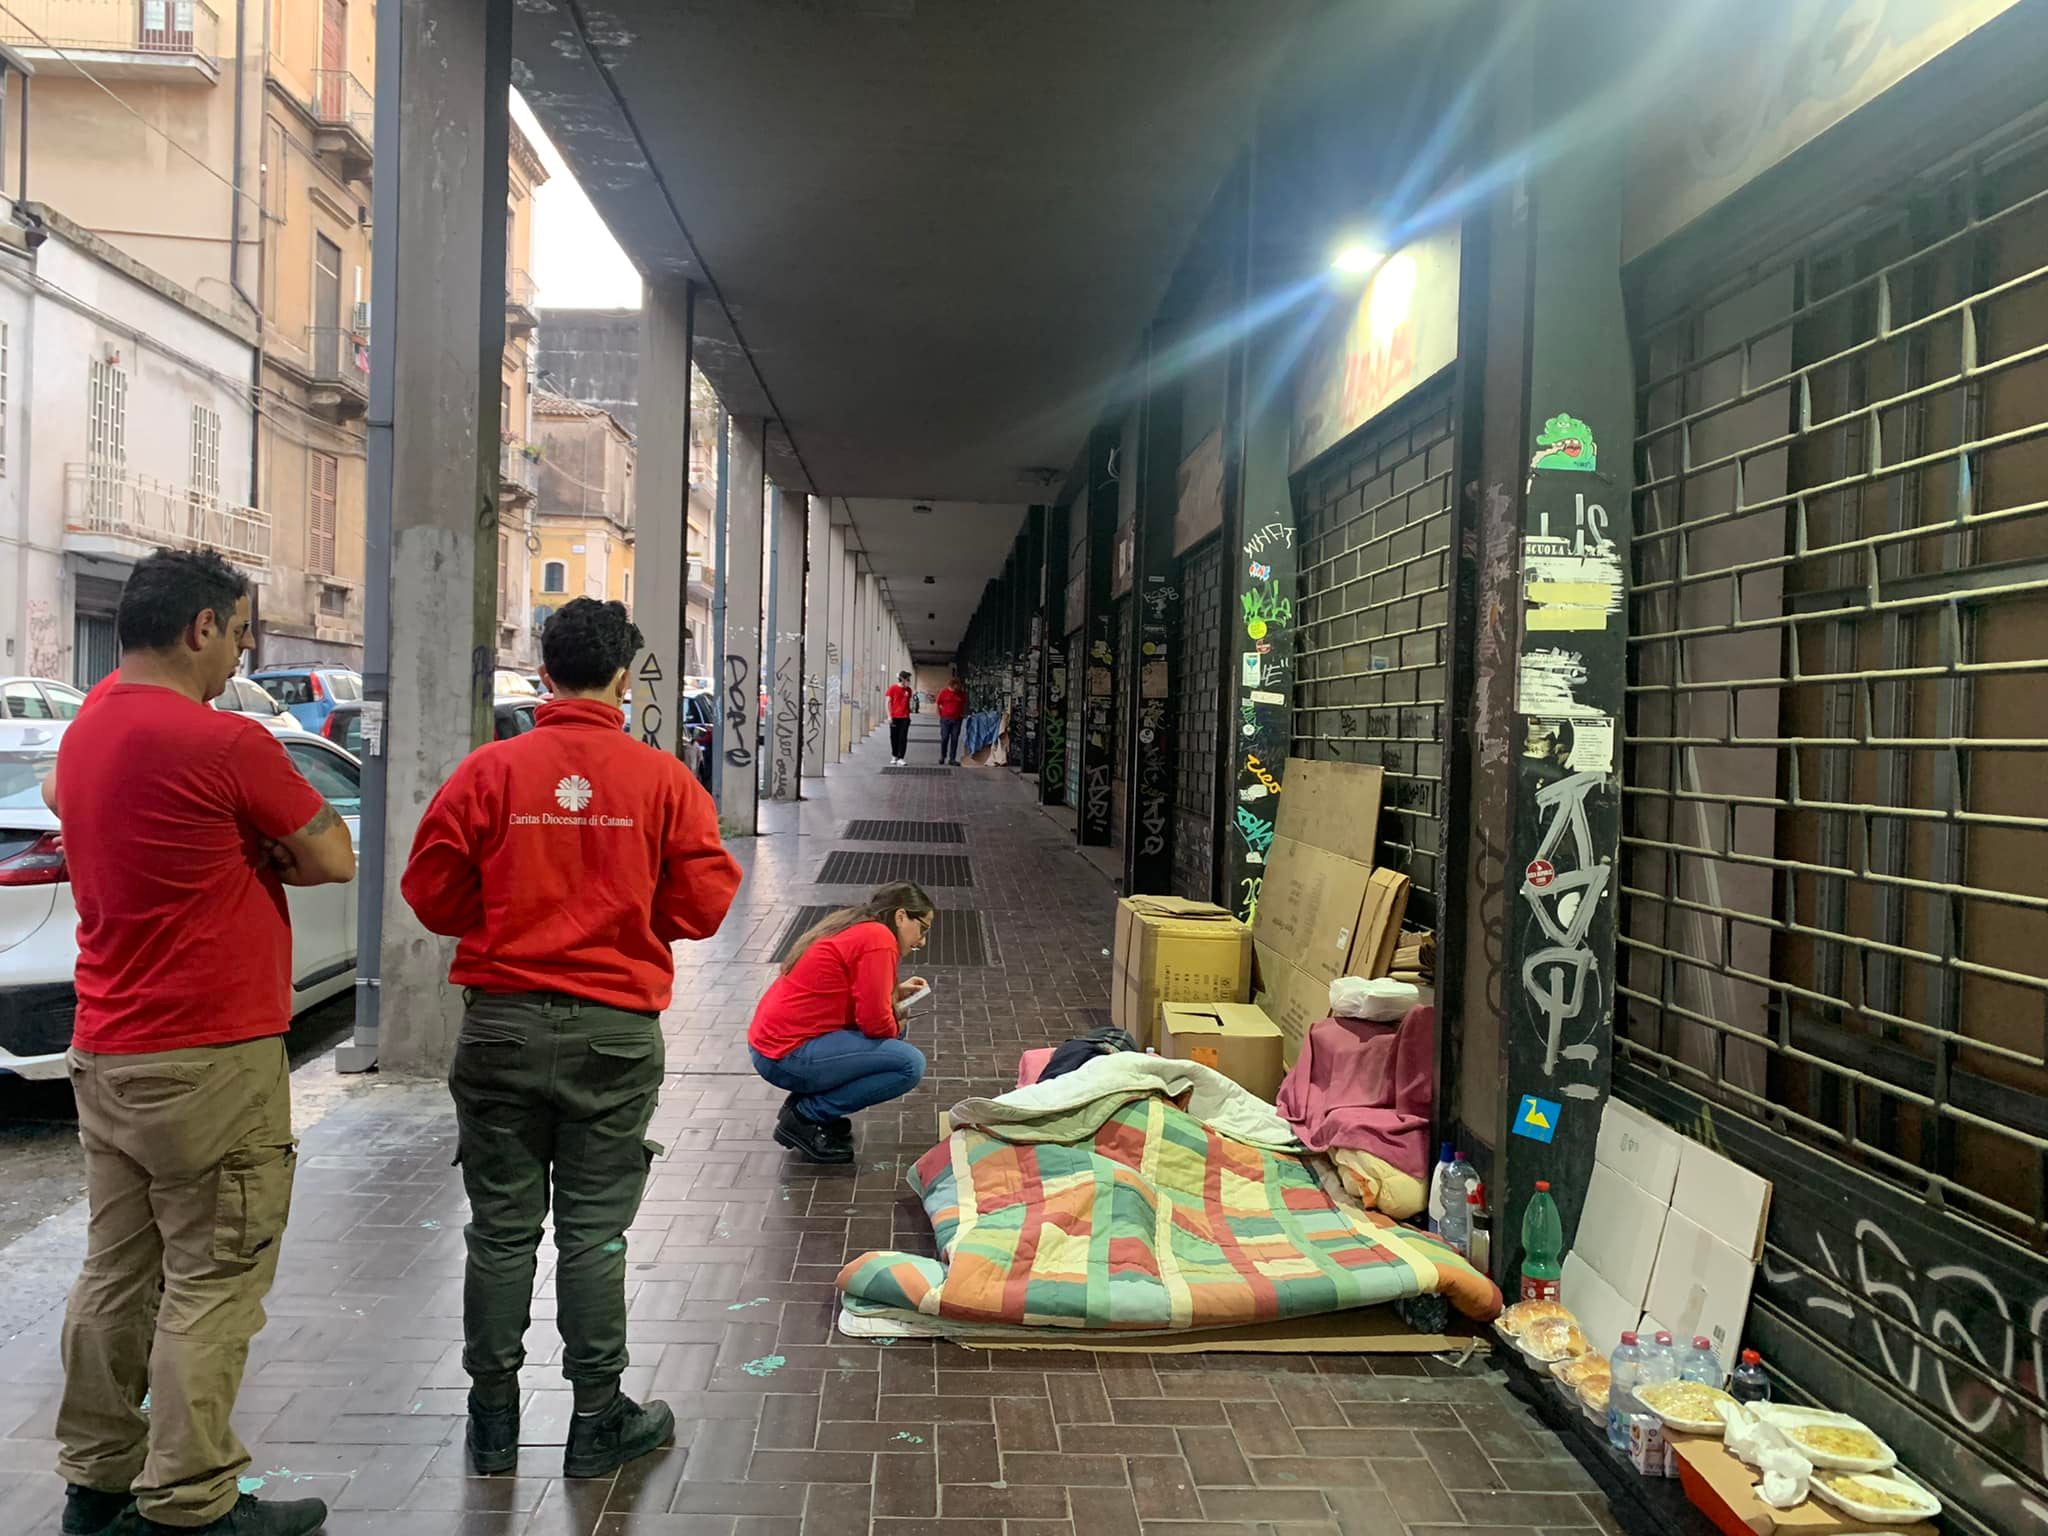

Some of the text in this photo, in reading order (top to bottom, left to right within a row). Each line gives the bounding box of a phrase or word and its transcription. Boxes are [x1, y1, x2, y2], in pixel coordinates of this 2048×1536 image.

[1243, 523, 1297, 559] WHAT
[1525, 543, 1565, 555] SCUOLA
[509, 813, 633, 827] Caritas Diocesana di Catania
